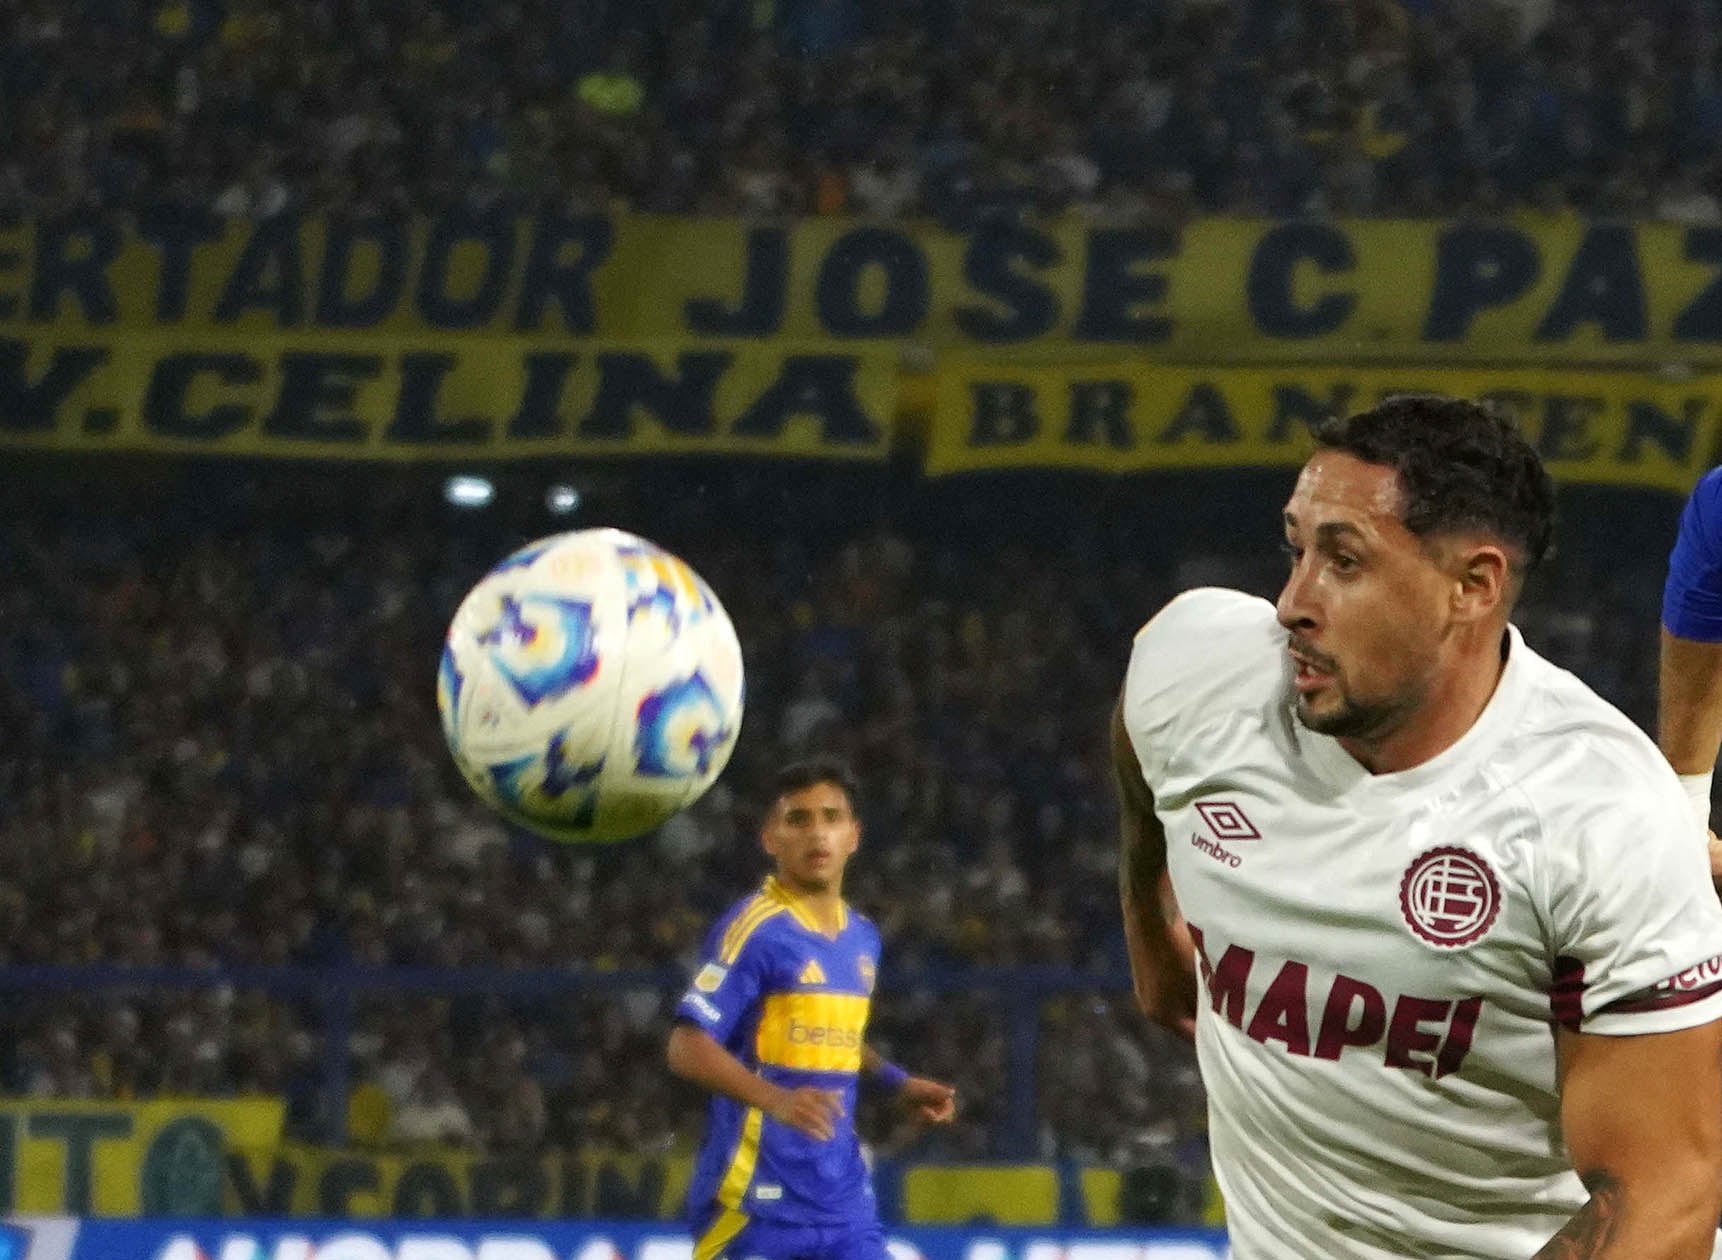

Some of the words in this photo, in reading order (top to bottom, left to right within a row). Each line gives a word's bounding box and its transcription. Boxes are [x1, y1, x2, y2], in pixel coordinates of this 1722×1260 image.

[682, 220, 1182, 342] JOSE
[1246, 221, 1360, 339] C
[1191, 832, 1242, 868] umbro
[1187, 922, 1482, 1079] MAPEI
